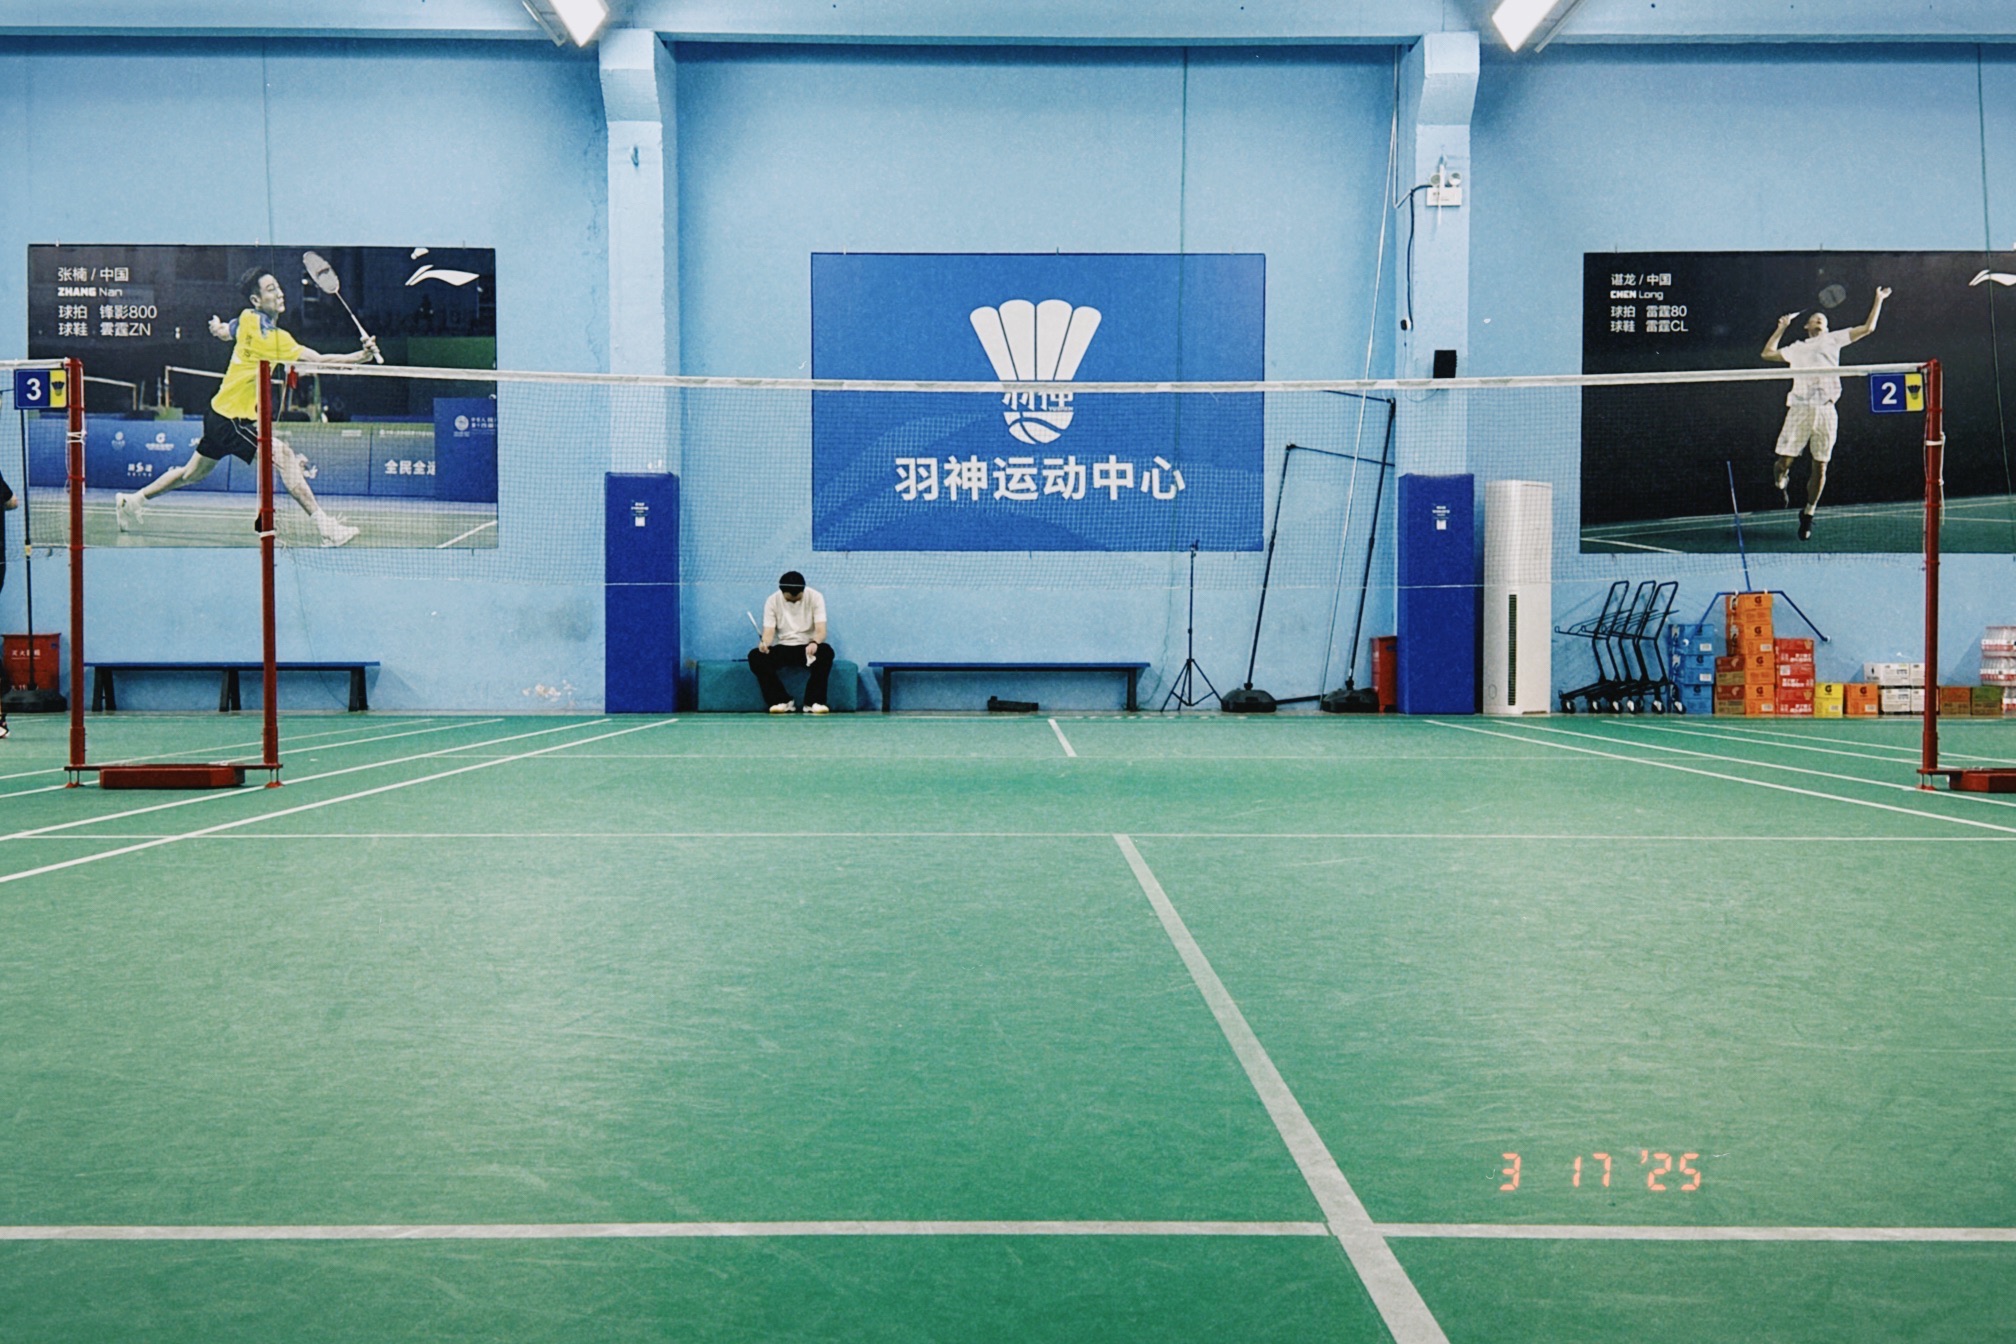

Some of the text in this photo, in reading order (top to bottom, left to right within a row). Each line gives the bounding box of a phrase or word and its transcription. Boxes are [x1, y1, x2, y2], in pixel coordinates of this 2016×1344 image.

[57, 266, 87, 282] 张楠
[99, 266, 129, 282] 中国
[1611, 273, 1636, 286] 谌龙
[1646, 273, 1672, 286] 中国
[57, 286, 123, 297] ZHANG Nan
[1610, 290, 1664, 300] CHEN Long
[58, 304, 88, 319] 球拍
[1610, 305, 1636, 318] 球拍
[58, 322, 88, 337] 球鞋
[1610, 320, 1635, 333] 球鞋
[26, 377, 42, 401] 3
[1881, 381, 1898, 405] 2
[894, 454, 1187, 501] 羽神运动中心
